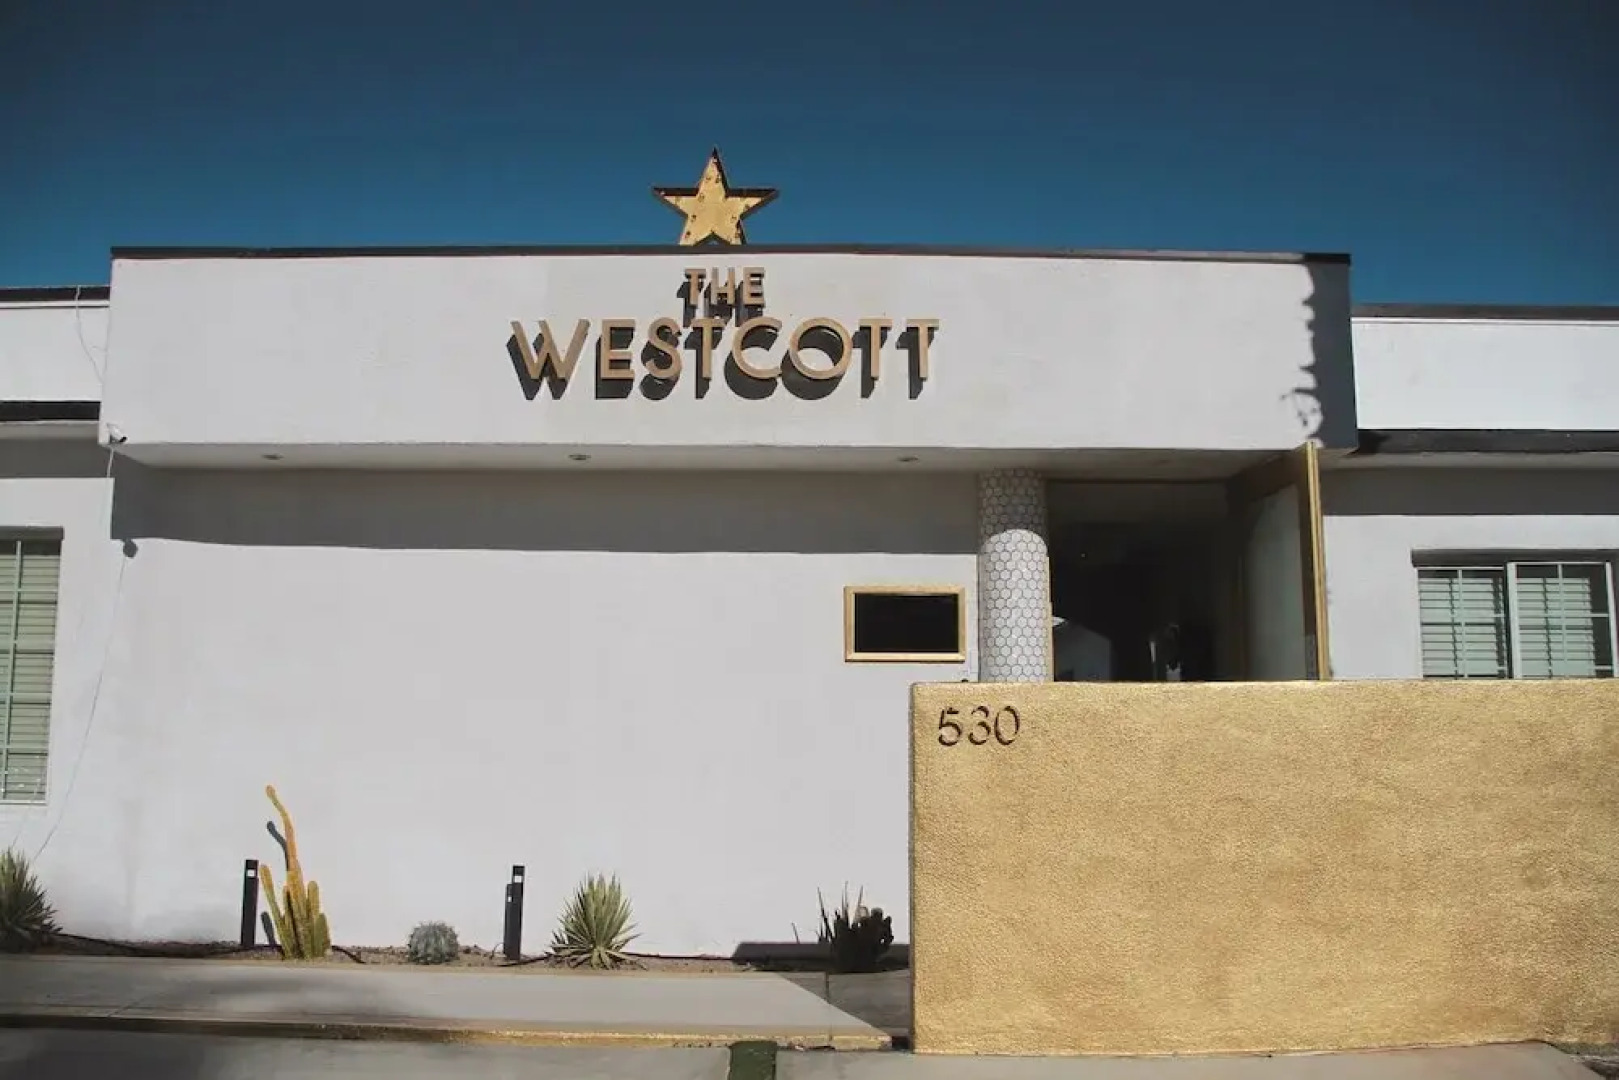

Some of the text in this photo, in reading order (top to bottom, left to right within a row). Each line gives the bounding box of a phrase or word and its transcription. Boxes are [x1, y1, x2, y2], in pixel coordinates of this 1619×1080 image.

[684, 266, 766, 306] THE
[511, 317, 940, 382] WESTCOTT
[938, 705, 1021, 746] 530
